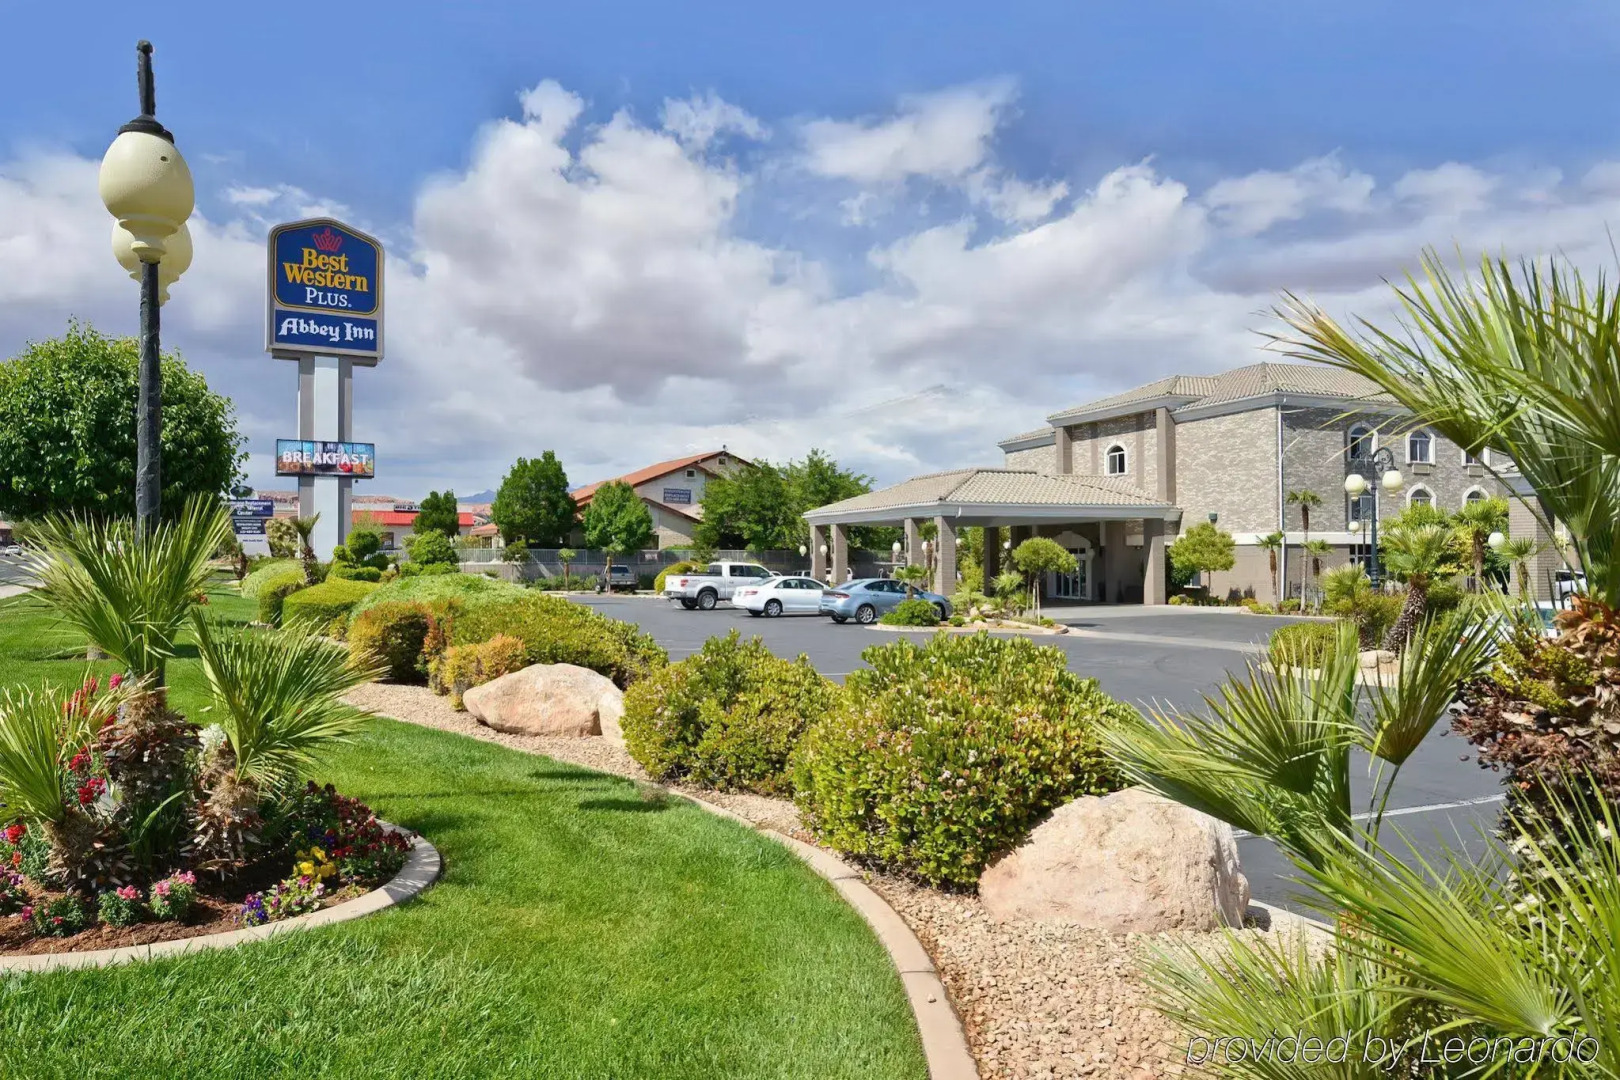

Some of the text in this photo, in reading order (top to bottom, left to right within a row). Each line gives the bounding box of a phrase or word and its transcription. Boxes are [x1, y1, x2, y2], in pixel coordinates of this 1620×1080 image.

[302, 247, 349, 273] Best
[283, 262, 369, 292] Western
[278, 317, 375, 342] Abbey Inn
[282, 450, 369, 465] BREAKFAST
